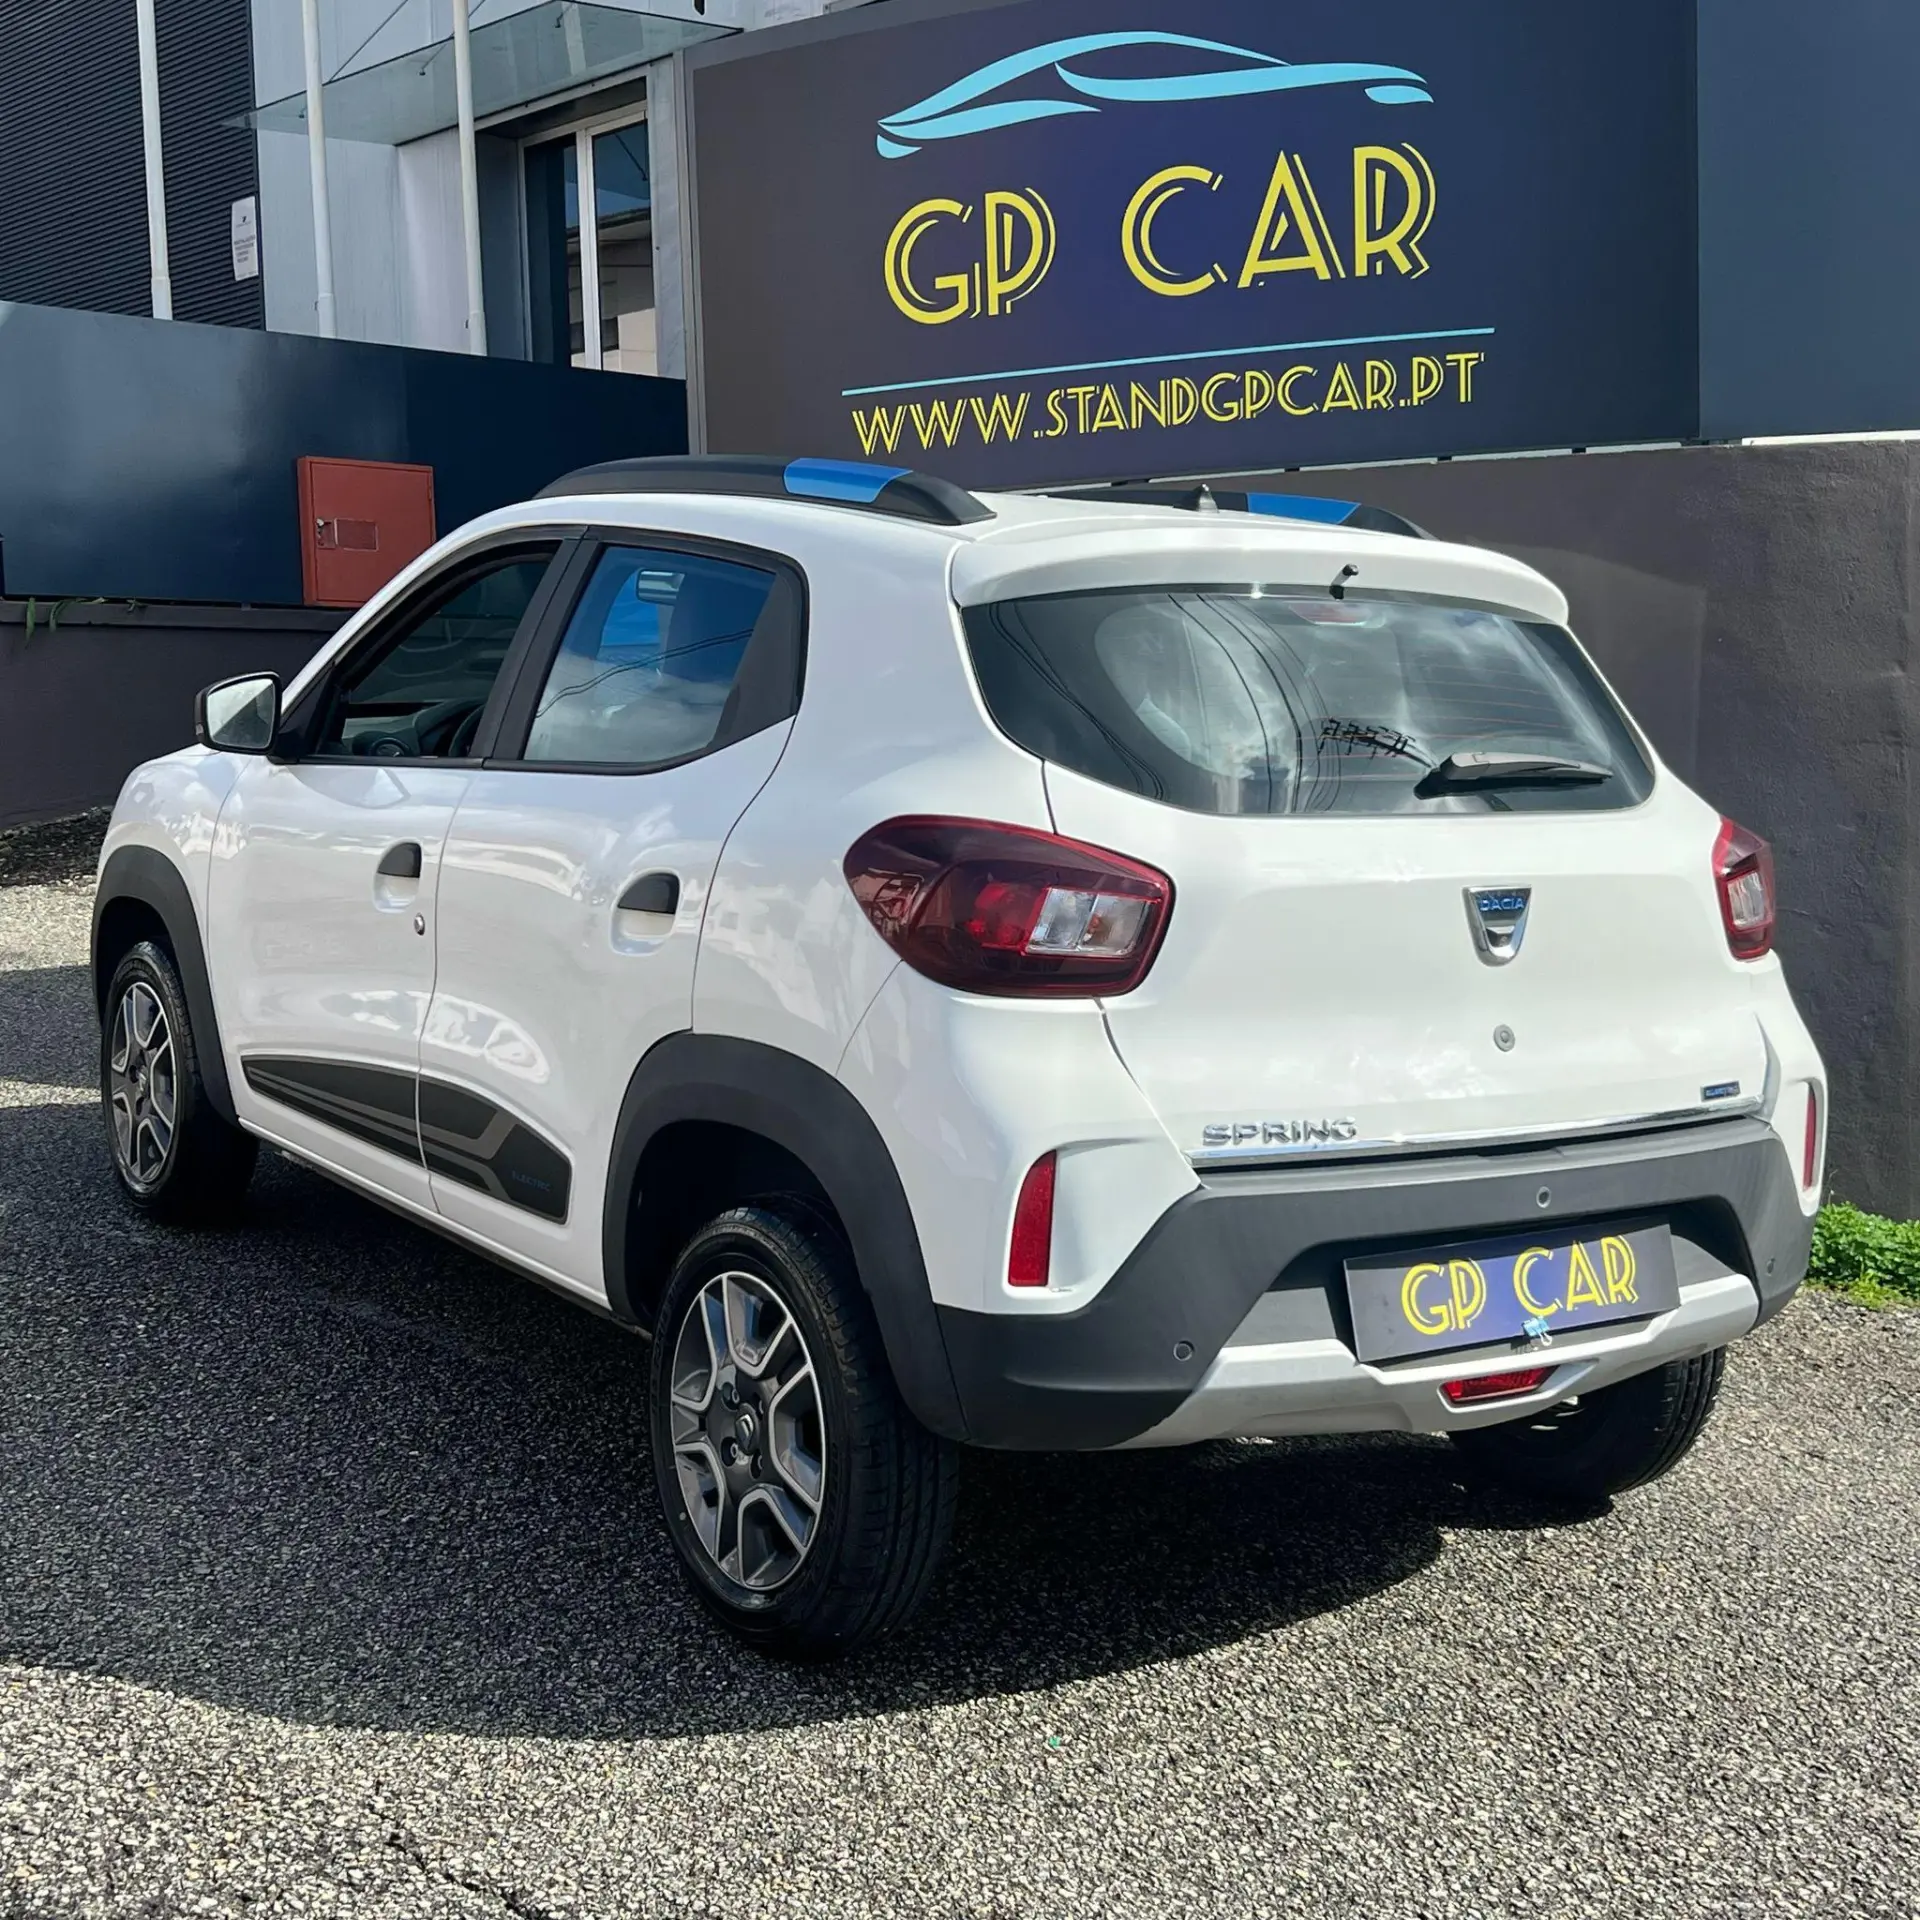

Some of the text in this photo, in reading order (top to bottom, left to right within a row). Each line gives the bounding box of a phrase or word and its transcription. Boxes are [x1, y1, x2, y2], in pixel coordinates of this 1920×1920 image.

[884, 143, 1436, 324] GP CAR
[852, 352, 1485, 455] WWW.STANDGPCAR.PT
[1479, 897, 1525, 911] DACIA
[1202, 1117, 1357, 1146] SPRING
[1400, 1234, 1640, 1336] GP CAR
